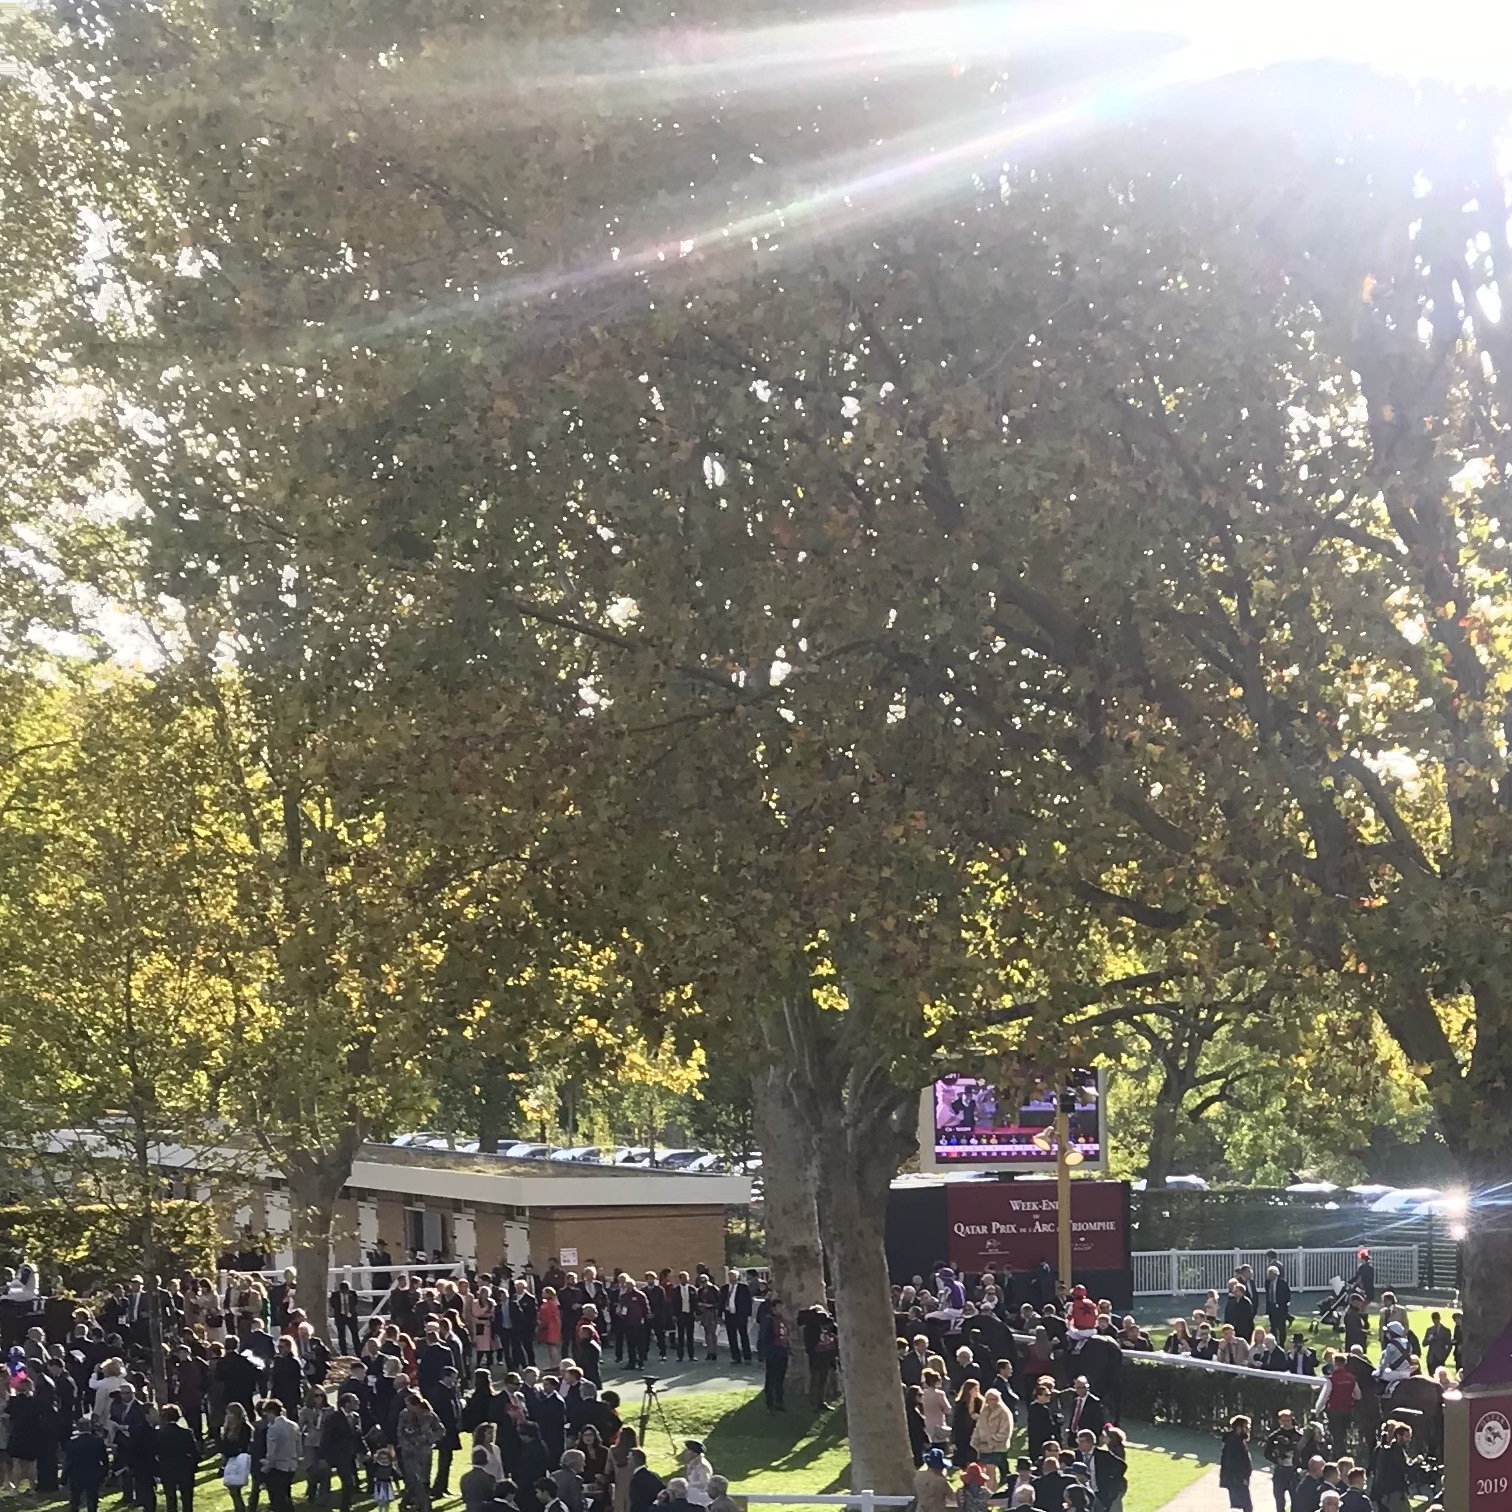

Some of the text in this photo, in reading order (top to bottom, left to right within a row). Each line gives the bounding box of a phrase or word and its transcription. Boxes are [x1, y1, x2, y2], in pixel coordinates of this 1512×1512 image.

[1009, 1199, 1059, 1211] WEEK-EN
[953, 1222, 989, 1237] QATAR
[991, 1221, 1018, 1234] PRIX
[1069, 1219, 1116, 1231] RIOMPHE
[950, 1318, 964, 1330] 12
[1477, 1477, 1508, 1495] 2019
